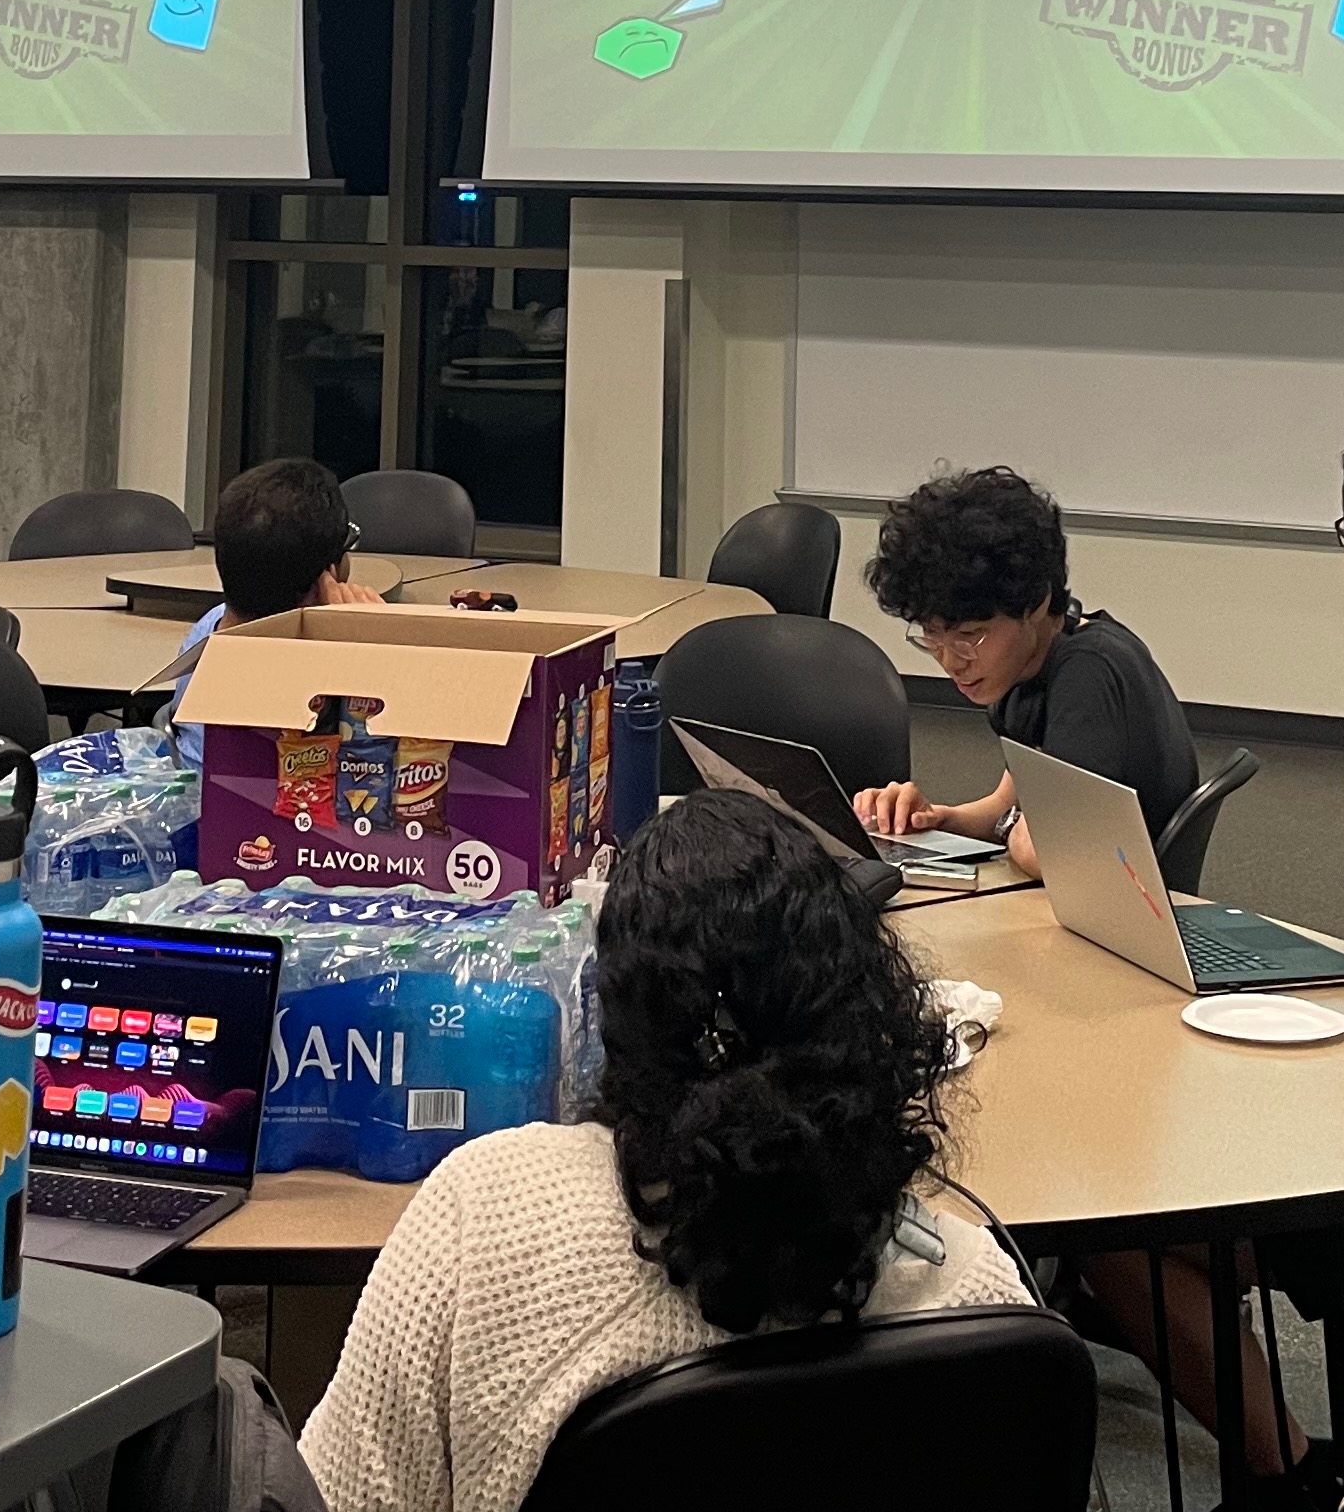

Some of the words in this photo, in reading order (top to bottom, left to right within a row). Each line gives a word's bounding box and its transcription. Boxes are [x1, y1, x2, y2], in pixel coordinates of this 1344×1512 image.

[10, 33, 63, 68] BONUS
[1132, 37, 1206, 77] BONUS
[284, 746, 328, 774] Cheetos
[340, 760, 385, 775] Doritos
[395, 763, 444, 789] Fritos
[297, 816, 310, 829] 16
[358, 821, 367, 832] 8
[410, 825, 419, 836] 8
[297, 848, 380, 873] FLAVOR
[386, 857, 425, 877] MIX
[453, 853, 494, 881] 50
[463, 881, 484, 889] BAGS
[262, 898, 458, 923] DASANI
[429, 1004, 465, 1028] 32
[268, 1007, 405, 1093] SANI
